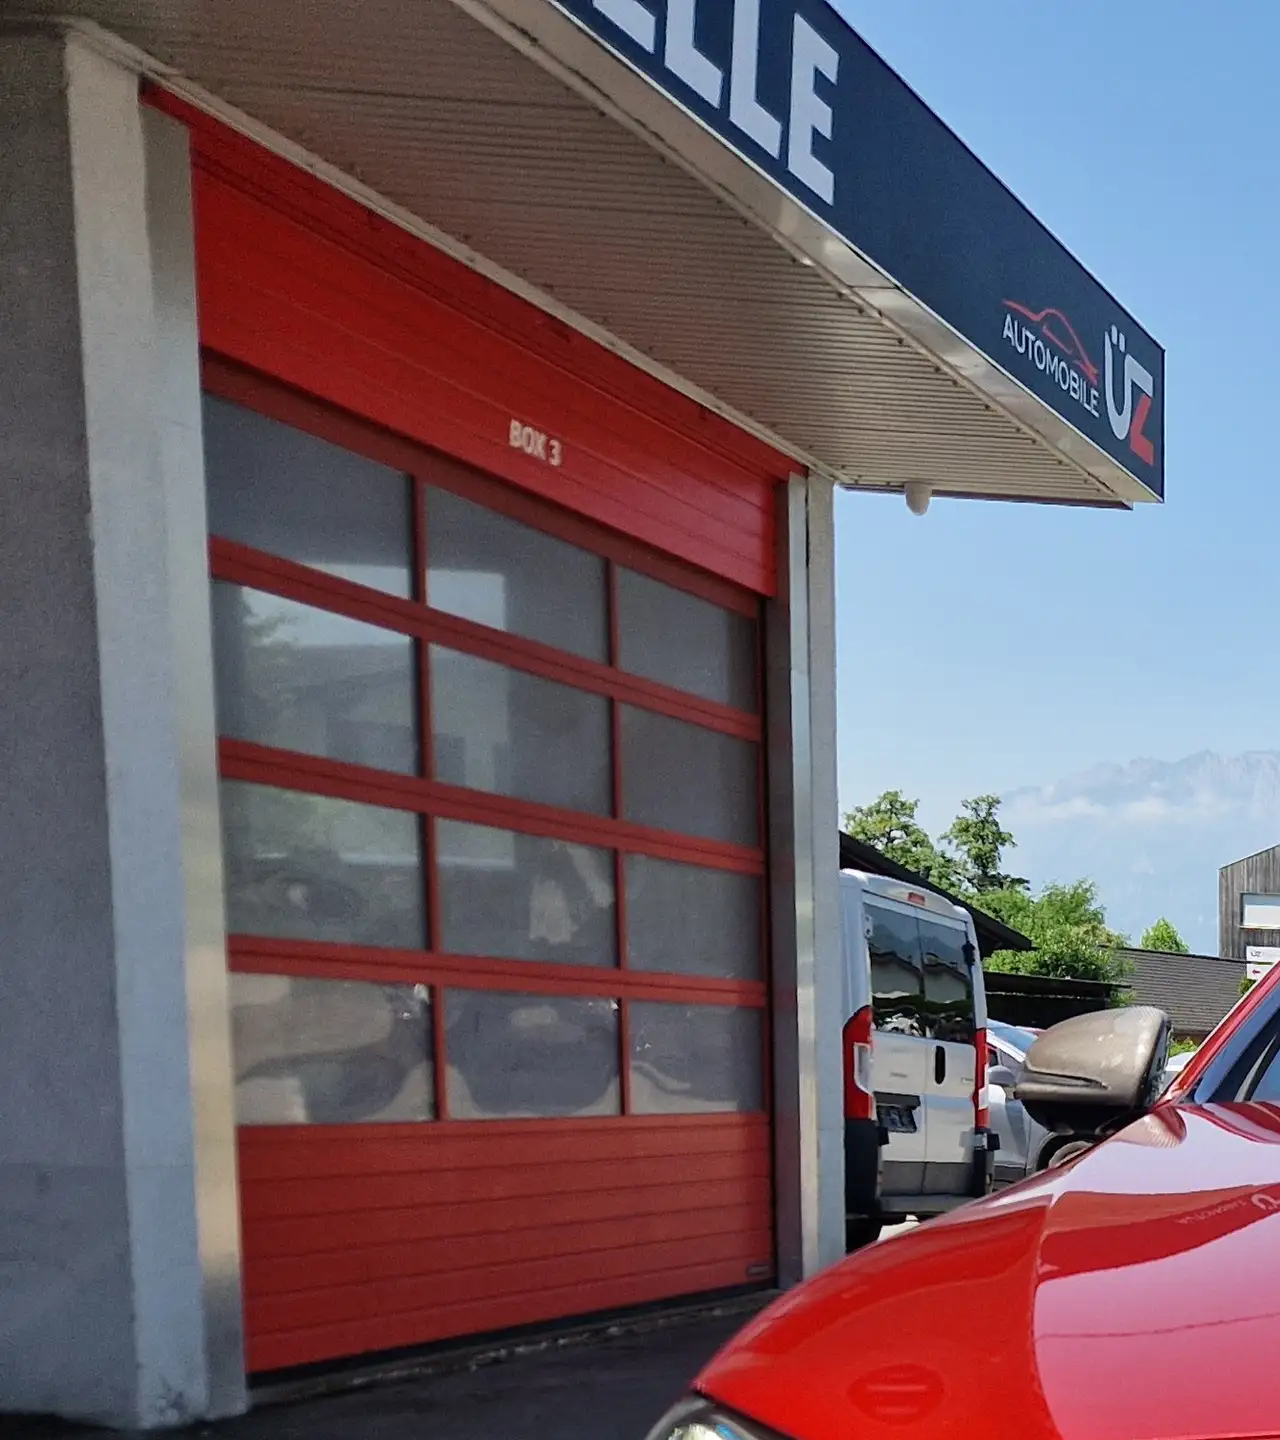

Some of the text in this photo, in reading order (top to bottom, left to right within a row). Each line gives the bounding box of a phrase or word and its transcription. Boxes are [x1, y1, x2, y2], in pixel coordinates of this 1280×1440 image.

[592, 0, 839, 205] LLE
[509, 419, 562, 466] BOX 3
[1002, 313, 1154, 467] AUTOMOBILE ÜZ
